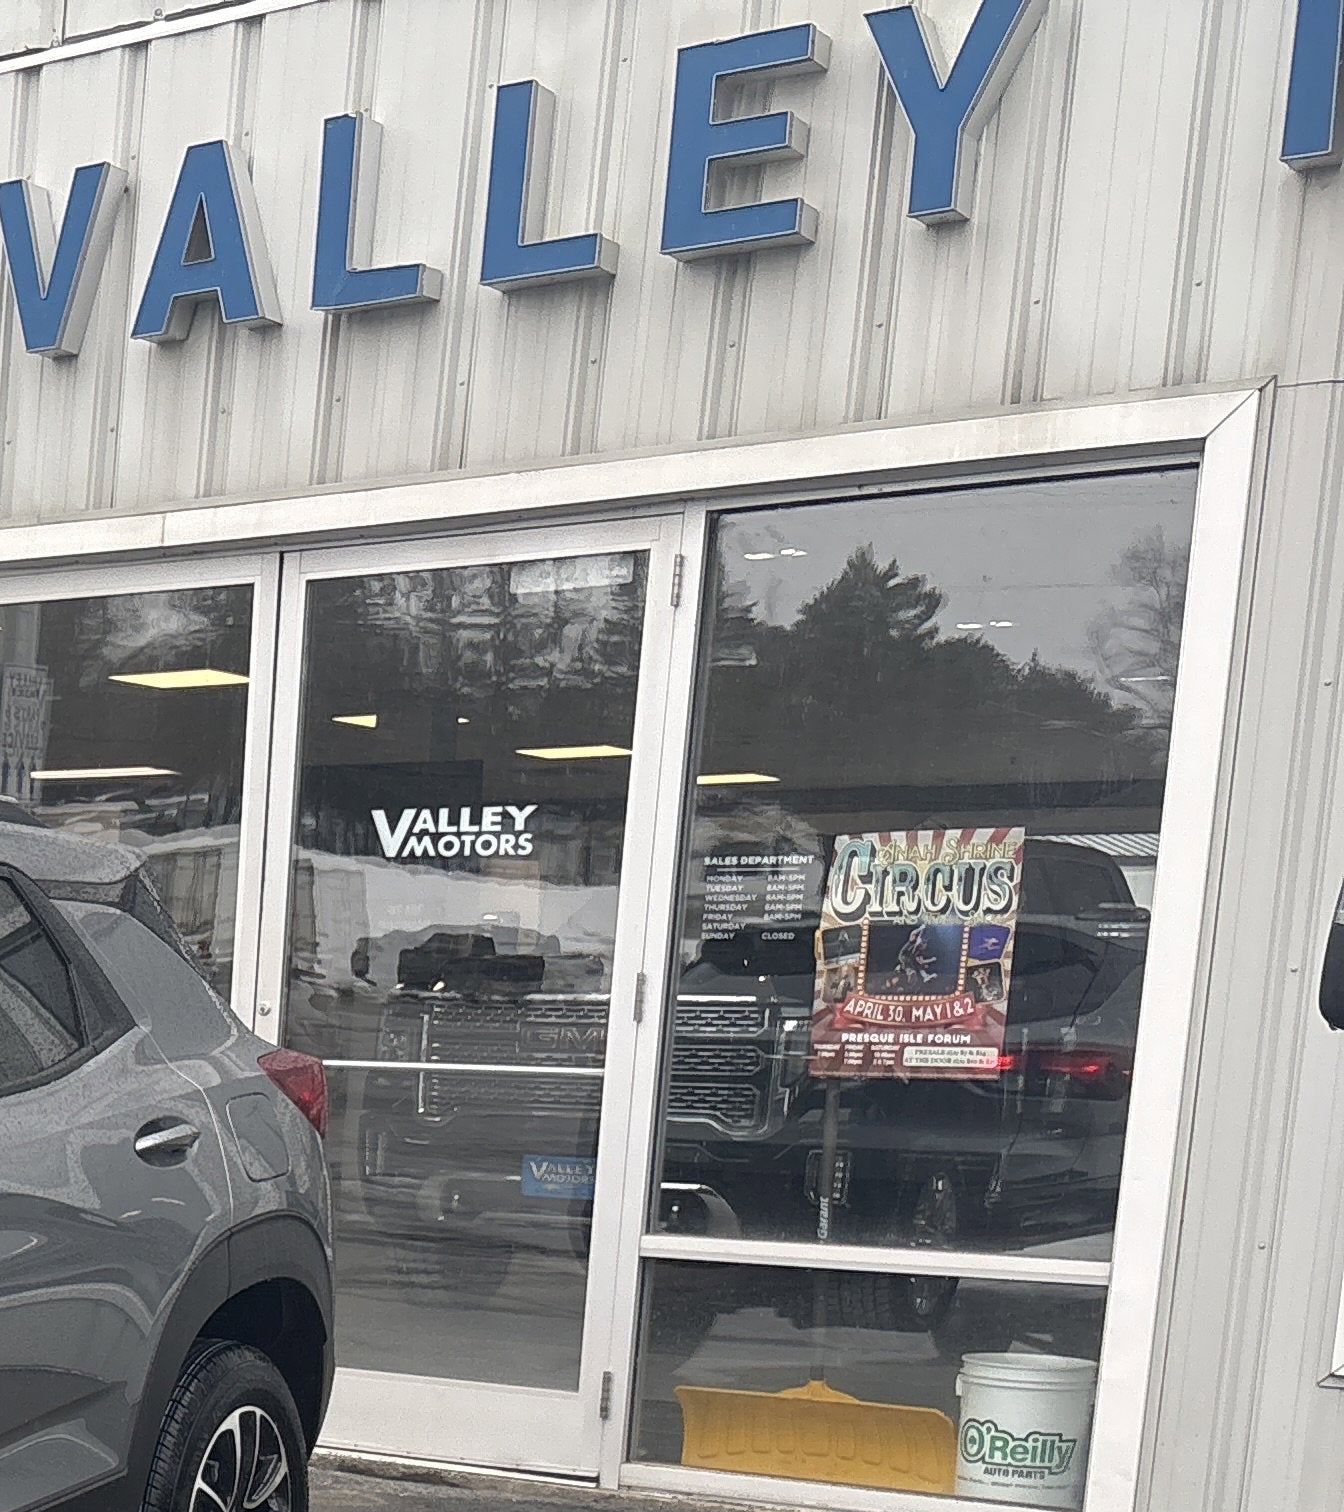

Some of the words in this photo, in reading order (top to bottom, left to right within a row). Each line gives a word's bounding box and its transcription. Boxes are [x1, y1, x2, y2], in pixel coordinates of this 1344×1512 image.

[371, 804, 539, 858] VALLEY
[401, 833, 534, 858] MOTORS
[941, 837, 1018, 864] SHRINE
[704, 856, 738, 865] SALES
[740, 855, 814, 865] DEPARTMENT
[832, 840, 1015, 922] CIRCUS
[701, 932, 735, 940] SUNDAY
[762, 932, 795, 940] CLOSED
[702, 922, 746, 930] SATURDAY
[843, 998, 884, 1018] APRIL
[912, 1003, 943, 1022] MAY
[953, 1000, 964, 1017] &
[964, 998, 974, 1015] 2
[521, 1026, 605, 1049] GM
[841, 1033, 895, 1043] PRESQUE
[899, 1033, 923, 1043] ISLE
[928, 1034, 971, 1044] FORUM
[963, 1422, 1073, 1470] O'Reilly
[983, 1467, 1010, 1478] AUTO
[1012, 1469, 1046, 1480] PARTS
